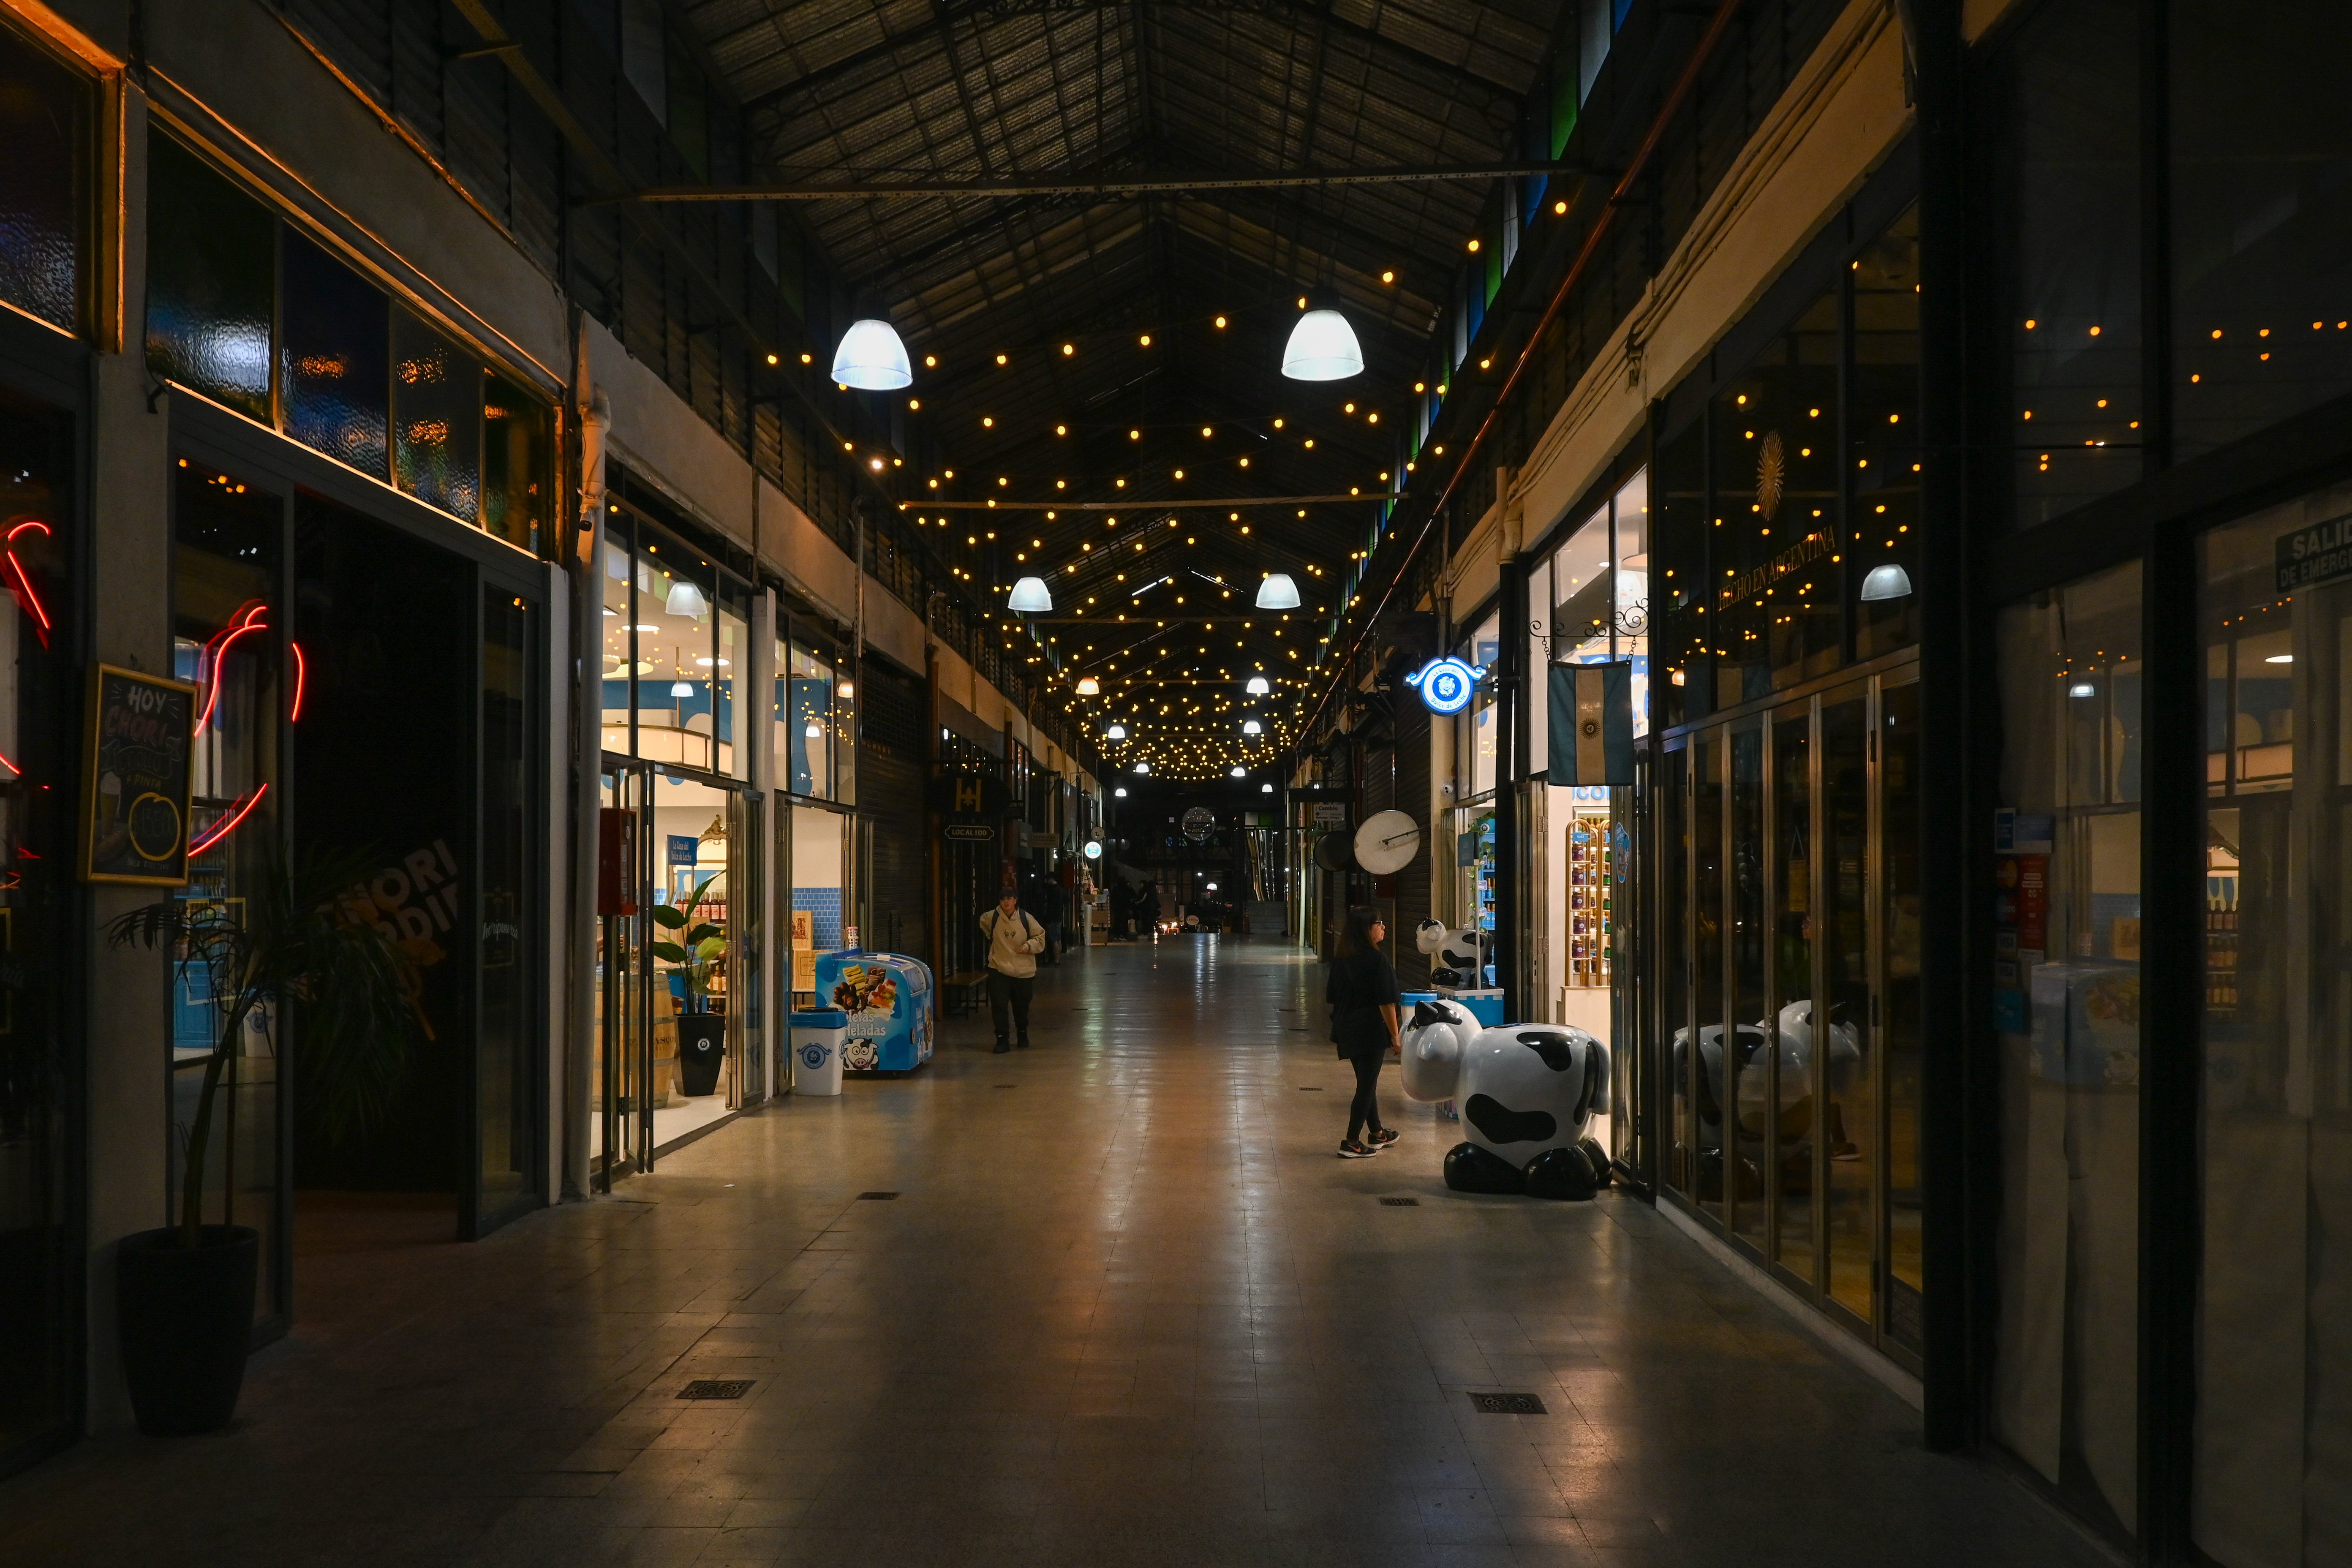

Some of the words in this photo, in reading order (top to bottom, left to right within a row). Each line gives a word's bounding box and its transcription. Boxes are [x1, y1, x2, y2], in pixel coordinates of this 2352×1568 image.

[1718, 573, 1751, 612] HECHO
[1753, 563, 1767, 593] EN
[1768, 524, 1836, 585] ARGENTINA
[2280, 565, 2297, 587] DE
[128, 685, 166, 714] HOY
[1431, 697, 1445, 708] Dulce
[105, 705, 168, 747] CHORI
[134, 773, 162, 791] PINTA
[673, 840, 676, 849] La
[847, 1010, 875, 1023] letas
